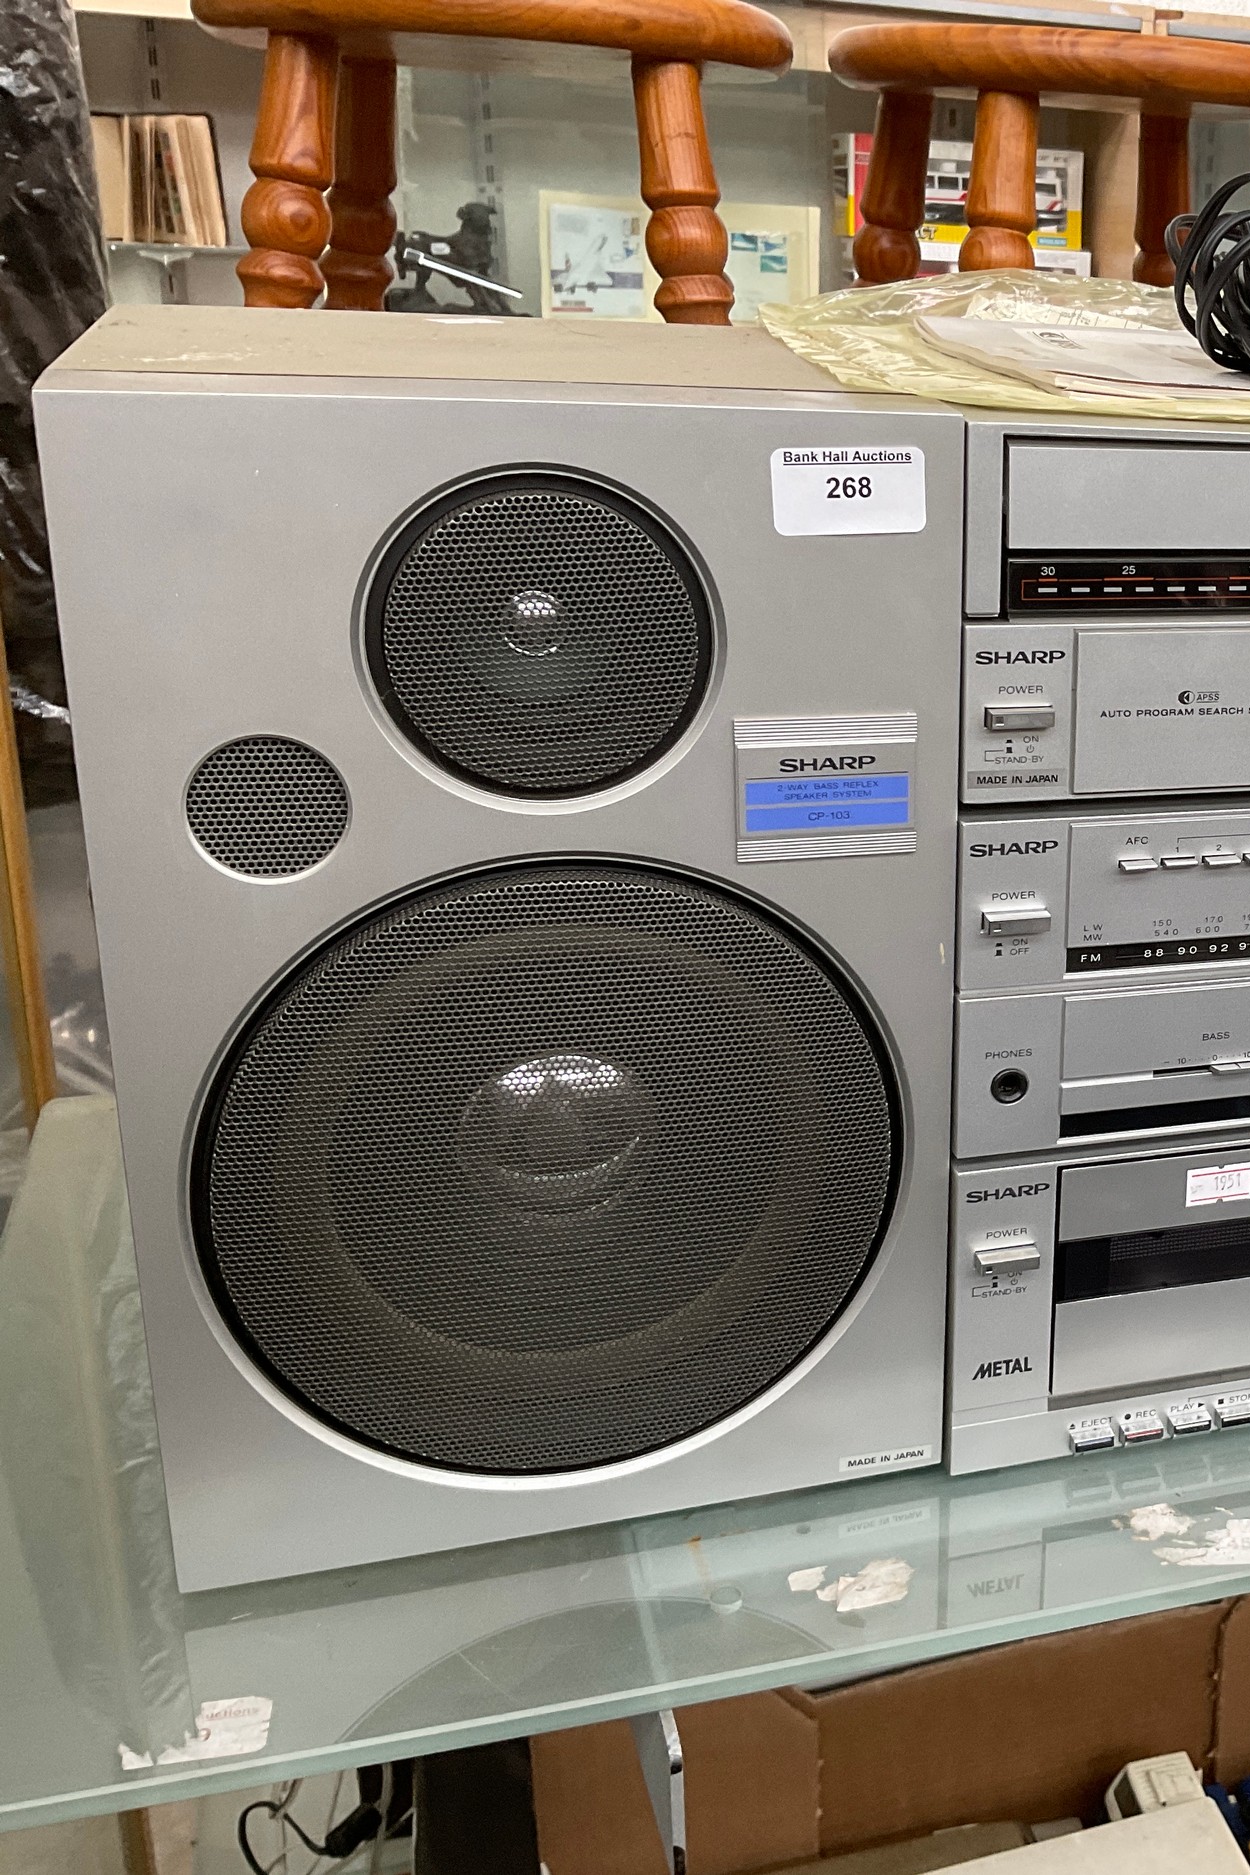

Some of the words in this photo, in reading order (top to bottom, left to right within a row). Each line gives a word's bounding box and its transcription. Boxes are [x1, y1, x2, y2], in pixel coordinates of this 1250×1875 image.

[783, 451, 819, 463] Bank
[822, 451, 848, 462] Hall
[852, 450, 912, 462] Auctions
[826, 476, 872, 499] 268
[1040, 566, 1056, 576] 30
[1122, 566, 1136, 576] 25
[975, 650, 1066, 665] SHARP
[998, 685, 1044, 695] POWER
[1196, 693, 1220, 701] APSS
[1100, 709, 1131, 718] AUTO
[1136, 708, 1195, 717] PROGRAM
[1198, 707, 1244, 716] SEARCH
[1023, 736, 1039, 744] ON
[779, 755, 876, 773] SHARP
[994, 756, 1044, 765] STAND-BY
[976, 776, 1007, 785] MADE
[1012, 775, 1023, 784] IN
[1025, 774, 1058, 784] JAPAN
[777, 784, 808, 792] 2-WAY
[814, 782, 839, 790] BASS
[843, 780, 879, 789] REFLEX
[784, 792, 828, 801] SPEAKER
[832, 790, 872, 799] SYSTEM
[808, 811, 850, 821] CP-103
[1125, 836, 1149, 845] AFC
[969, 840, 1059, 857] SHARP
[992, 890, 1036, 901] POWER
[1012, 938, 1028, 946] ON
[1083, 933, 1103, 942] MW
[1009, 948, 1030, 956] OFF
[1080, 953, 1101, 963] FM
[1202, 1031, 1231, 1041] BASS
[985, 1048, 1033, 1060] PHONES
[1214, 1173, 1241, 1191] 1951
[966, 1183, 1050, 1203] SHARP
[986, 1227, 1028, 1239] POWER
[981, 1286, 1028, 1299] STAND-BY
[972, 1356, 1032, 1380] METAL
[1170, 1403, 1195, 1412] PLAY
[1135, 1409, 1157, 1418] REC
[1081, 1416, 1113, 1428] EJECT
[847, 1456, 876, 1467] MADE
[880, 1455, 891, 1463] IN
[893, 1449, 925, 1461] JAPAN
[204, 1707, 259, 1719] uctions
